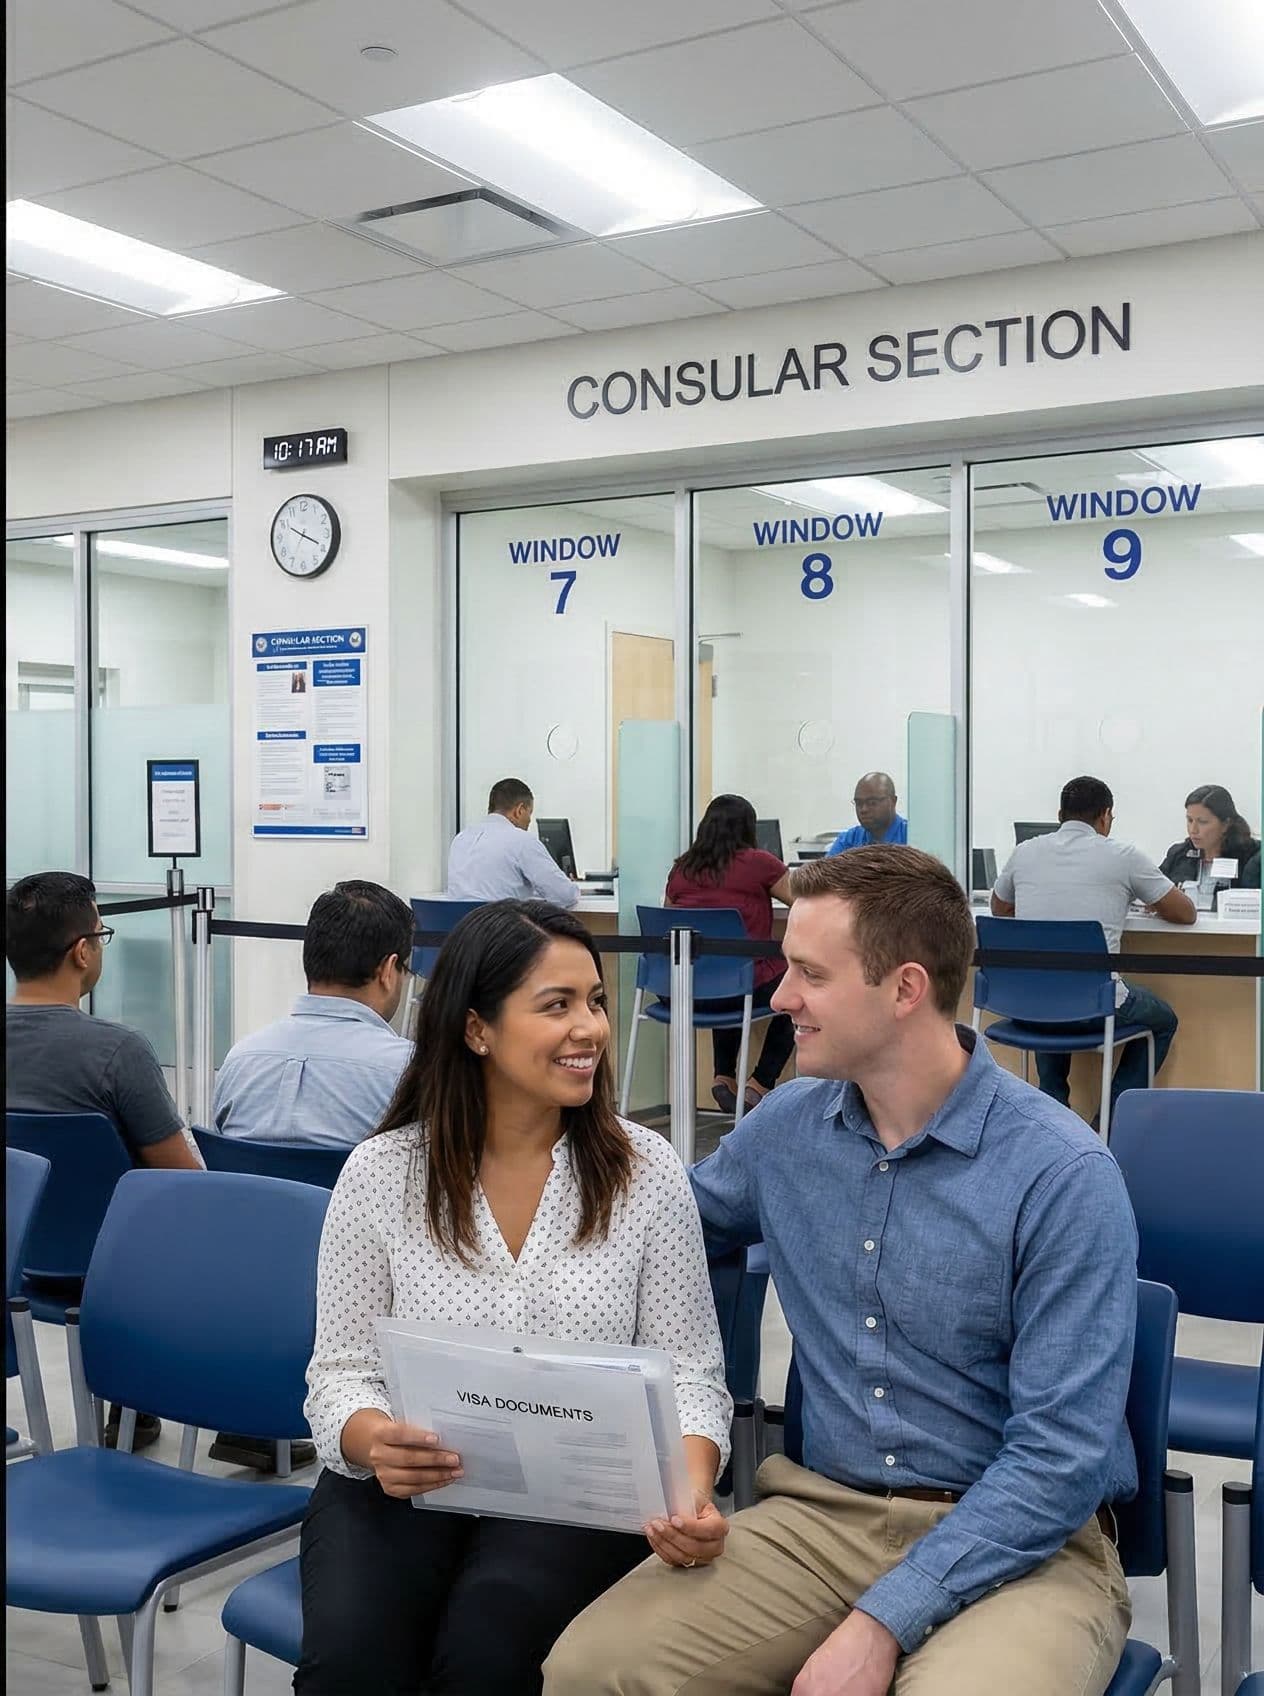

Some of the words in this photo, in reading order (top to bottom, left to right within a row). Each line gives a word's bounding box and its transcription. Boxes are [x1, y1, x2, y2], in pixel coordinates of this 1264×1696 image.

[566, 342, 849, 420] CONSULAR
[866, 301, 1132, 383] SECTION
[299, 500, 308, 512] 12
[1045, 482, 1203, 522] WINDOW
[320, 514, 327, 525] 2
[752, 511, 884, 546] WINDOW
[280, 547, 287, 558] 8
[289, 557, 296, 568] 7
[312, 555, 319, 566] 5
[508, 533, 622, 565] WINDOW
[1101, 527, 1143, 581] 9
[549, 569, 578, 615] 7
[799, 551, 835, 601] 8
[456, 1389, 492, 1409] VISA
[495, 1397, 593, 1422] DOCUMENTS
